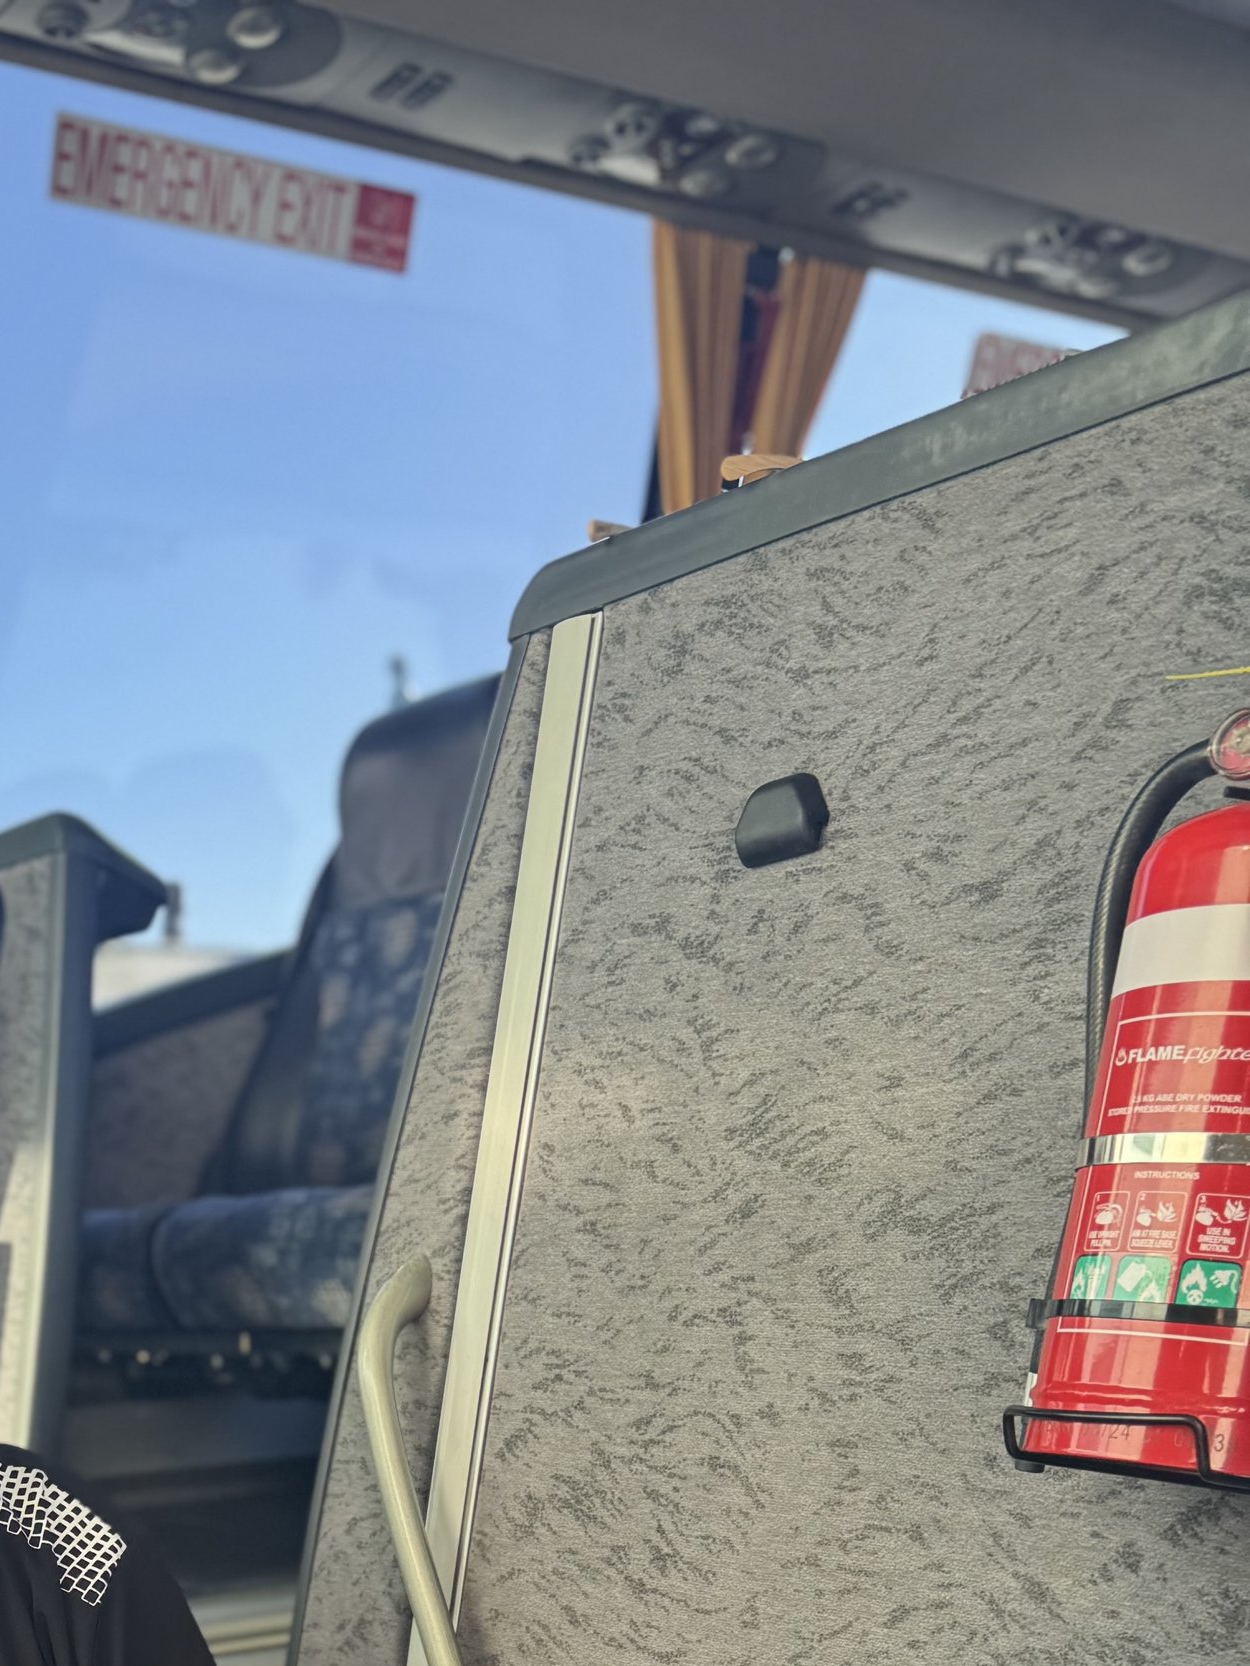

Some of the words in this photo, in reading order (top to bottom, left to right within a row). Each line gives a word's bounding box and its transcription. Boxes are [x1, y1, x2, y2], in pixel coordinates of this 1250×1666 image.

[53, 121, 270, 236] EMERGENCY
[275, 173, 347, 255] EXIT
[1175, 1093, 1194, 1102] DRY
[1197, 1093, 1242, 1103] POWDER
[1179, 1105, 1200, 1113] FIRE
[1134, 1171, 1200, 1180] INSTRUCTIONS
